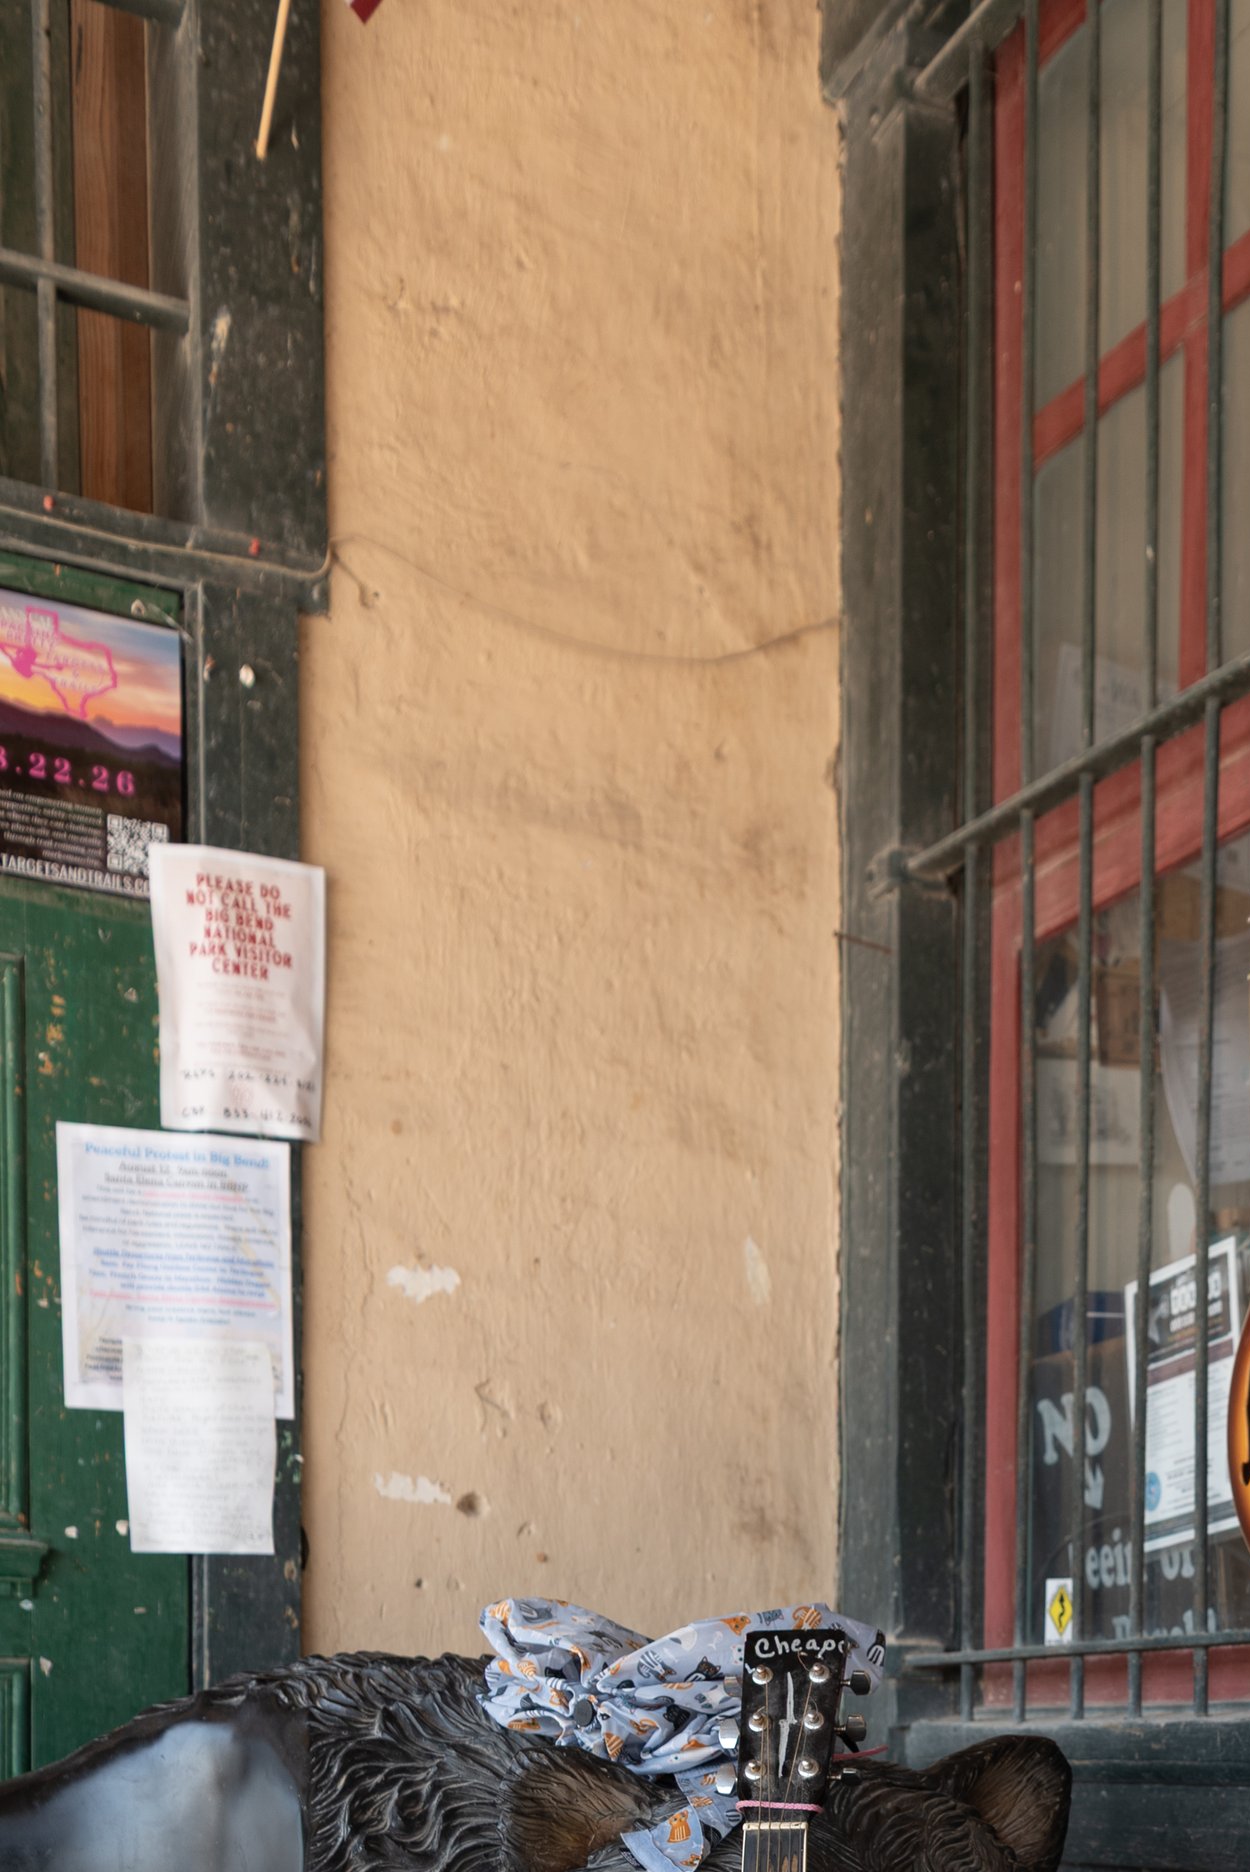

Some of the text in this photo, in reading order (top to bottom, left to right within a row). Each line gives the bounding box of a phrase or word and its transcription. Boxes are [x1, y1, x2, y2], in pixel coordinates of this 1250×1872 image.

[196, 872, 280, 900] PLEASE DO
[186, 890, 291, 918] NOT CALL THE
[205, 909, 274, 931] BIG BEND
[204, 926, 275, 948] NATIONAL
[189, 942, 292, 968] PARK VISITOR
[212, 958, 268, 980] CENTER
